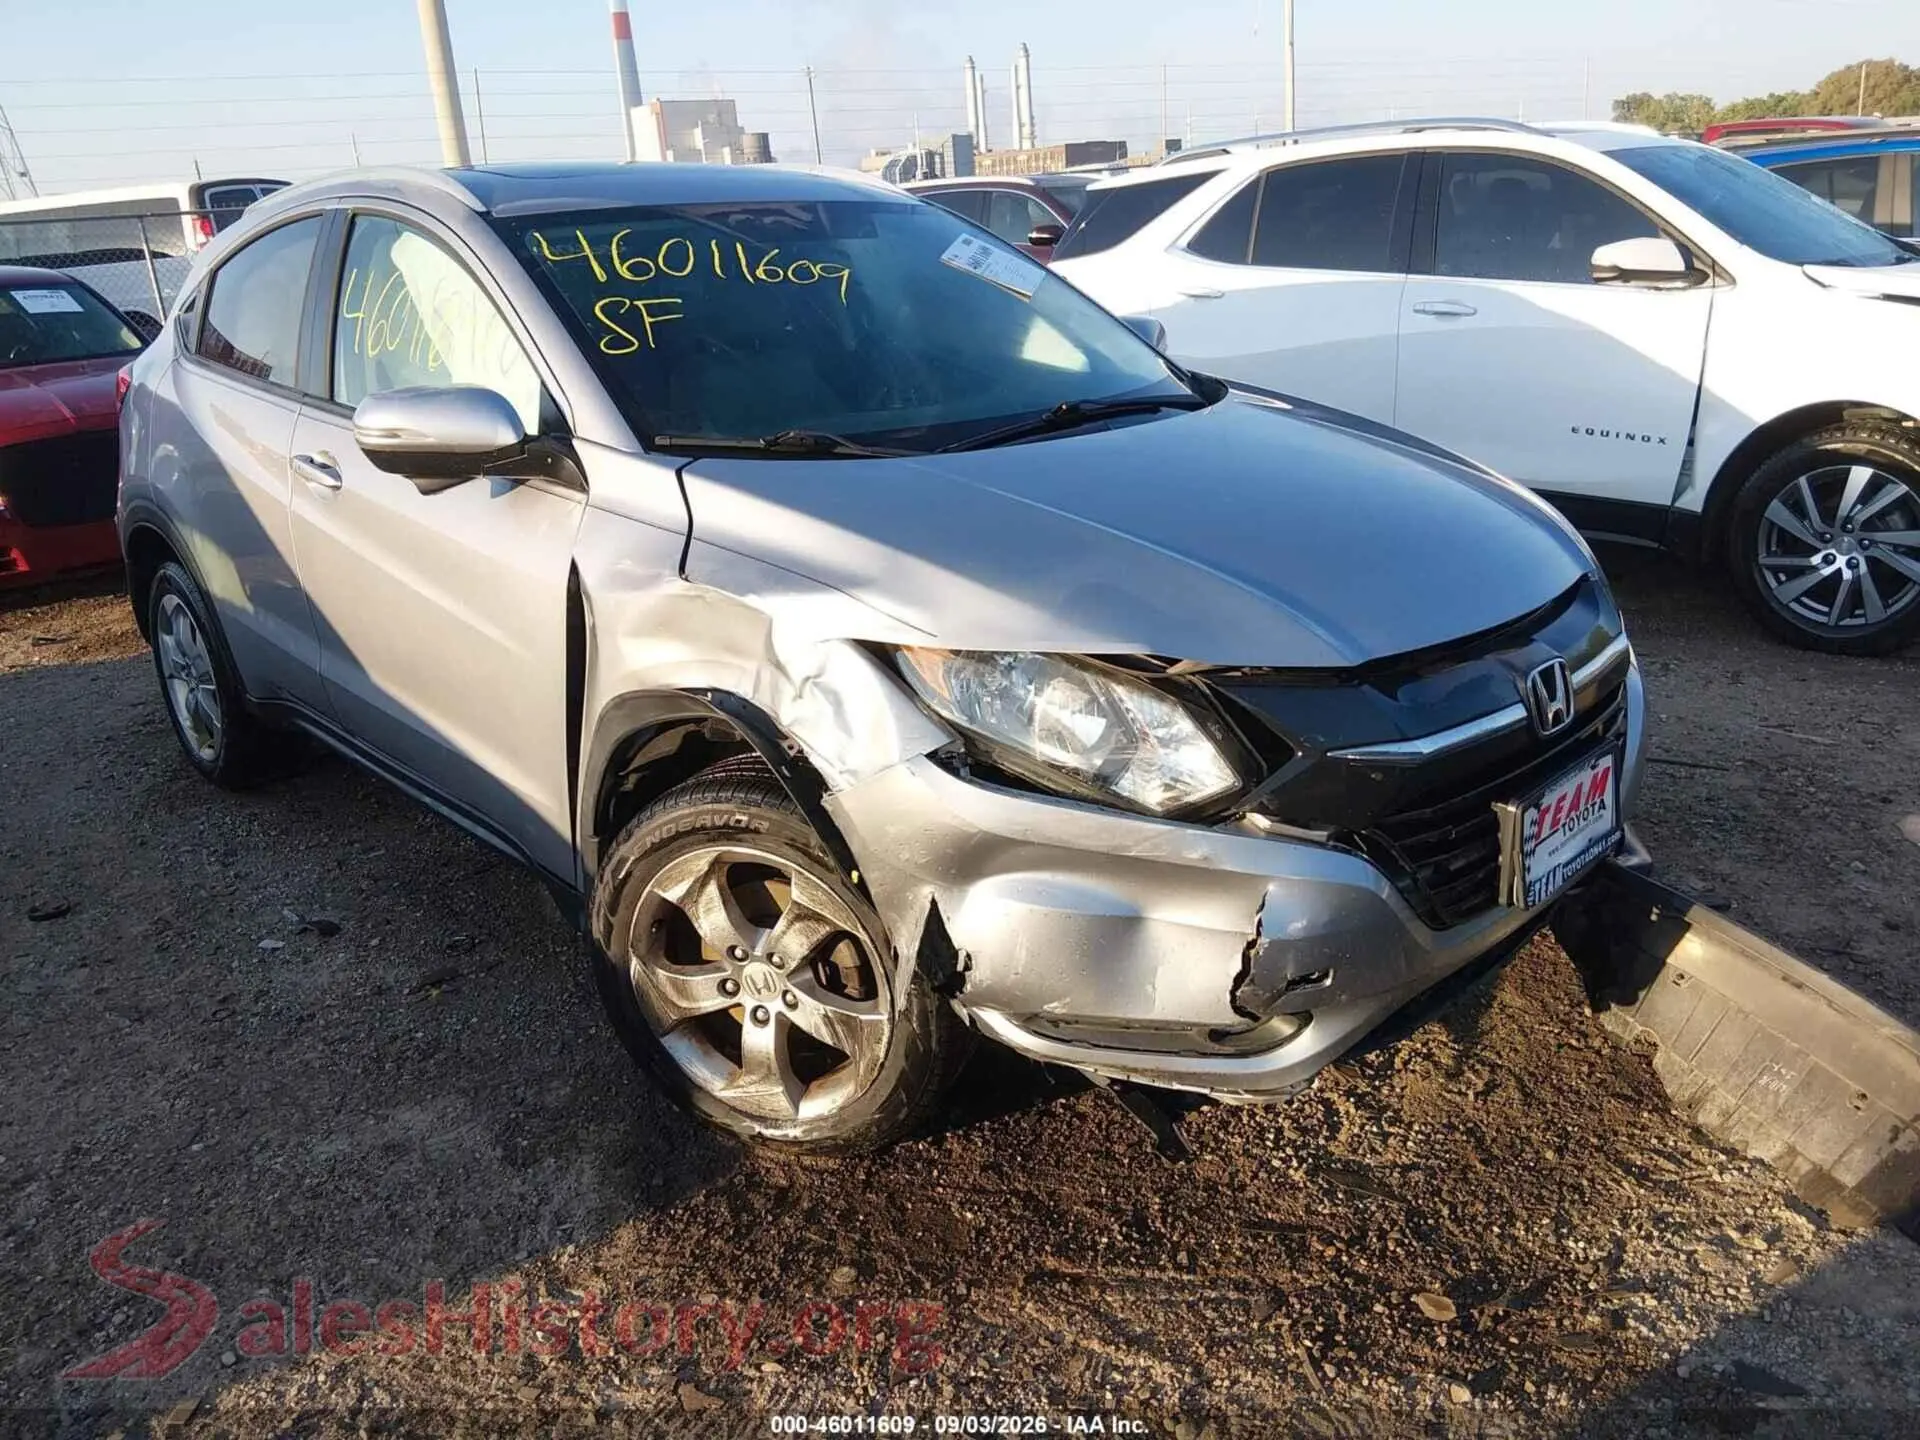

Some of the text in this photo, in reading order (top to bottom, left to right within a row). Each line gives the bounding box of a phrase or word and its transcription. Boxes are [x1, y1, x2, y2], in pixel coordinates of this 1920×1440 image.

[532, 227, 852, 305] 46011609
[595, 297, 684, 355] SF
[1571, 426, 1668, 446] EQUINOX
[1534, 766, 1612, 842] TEAM
[1562, 798, 1607, 837] TOYOTA
[631, 812, 770, 858] ENDEAVOR
